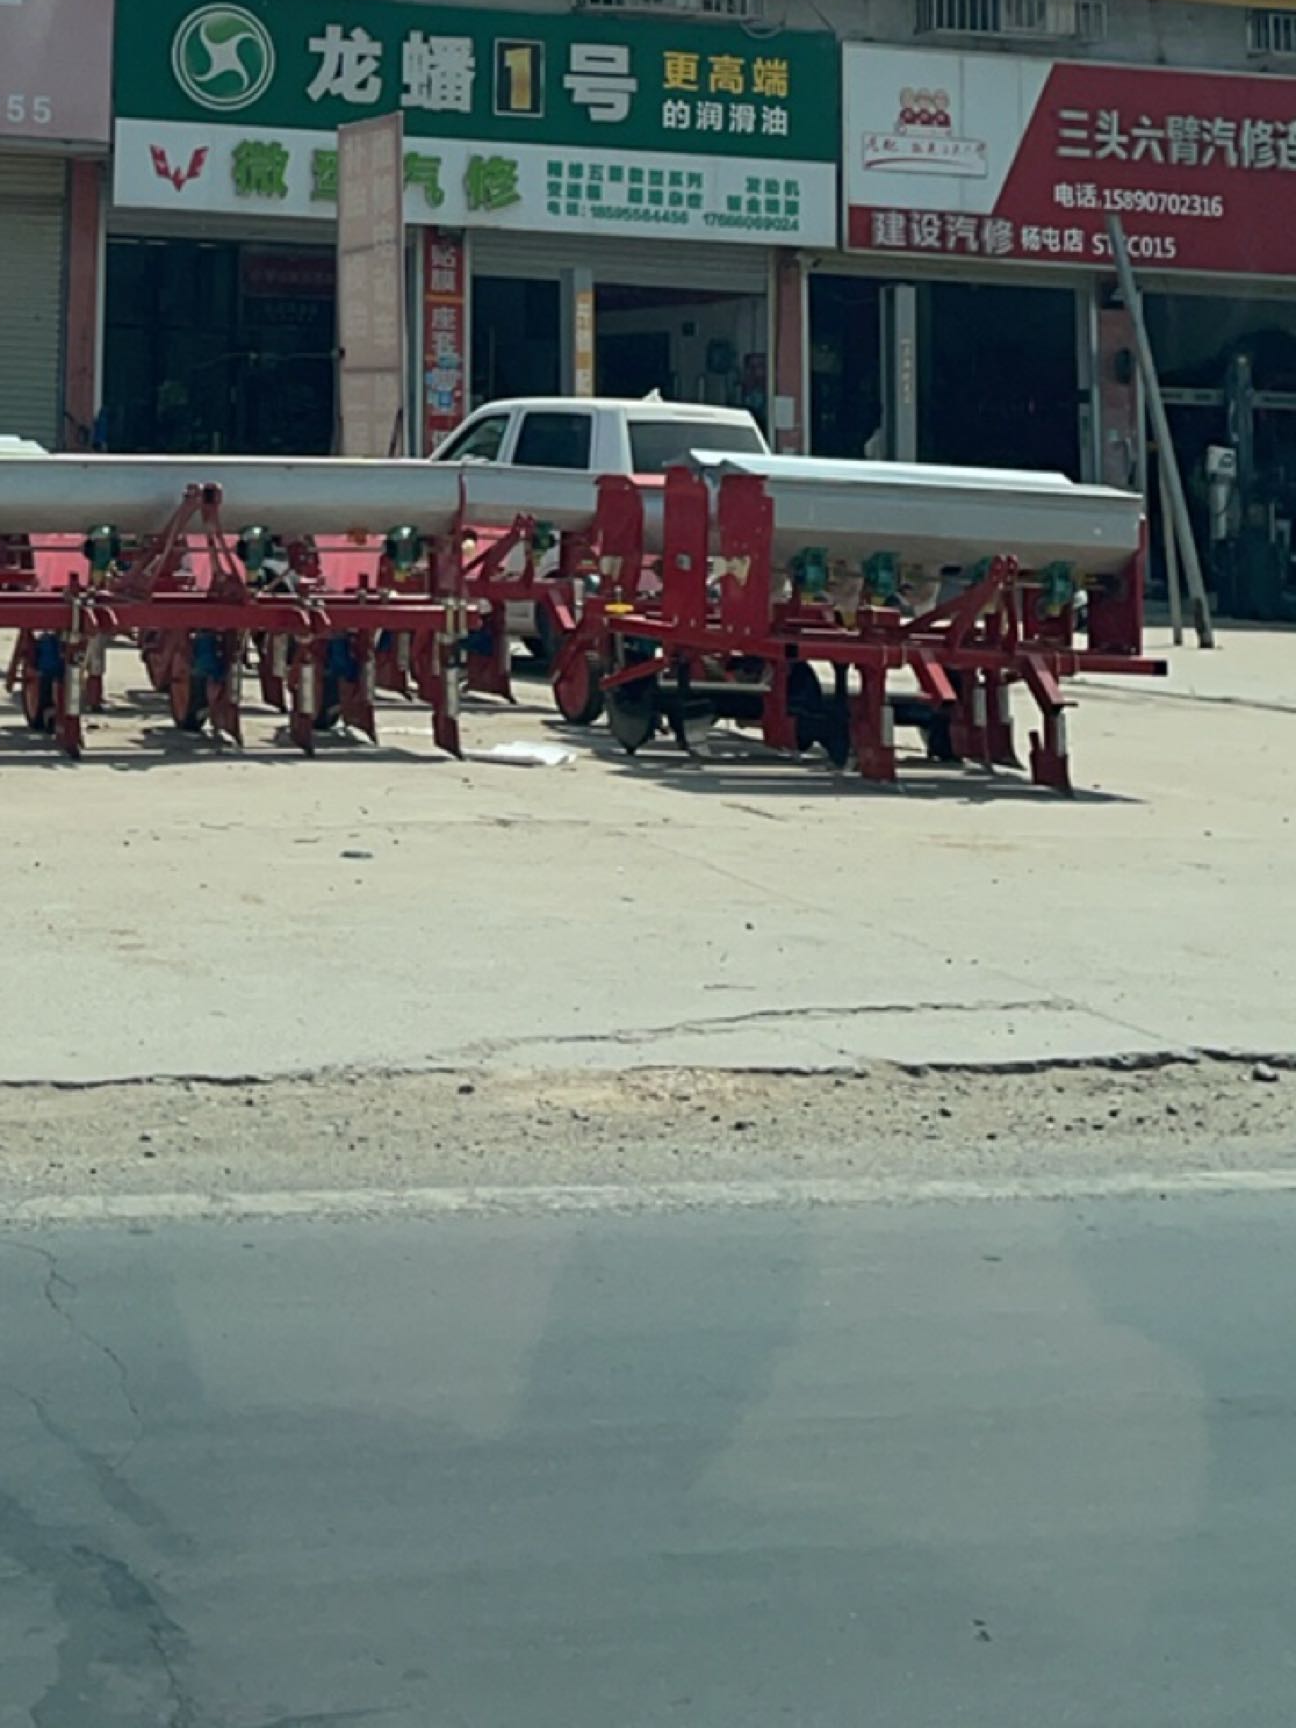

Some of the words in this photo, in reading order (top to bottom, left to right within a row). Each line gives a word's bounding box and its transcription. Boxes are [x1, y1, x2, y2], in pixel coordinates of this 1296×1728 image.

[307, 24, 638, 121] 龙蟠1号
[663, 51, 789, 98] 更高端
[662, 99, 789, 136] 的润滑油
[872, 211, 1014, 254] 建设汽修
[1092, 233, 1176, 259] STC015
